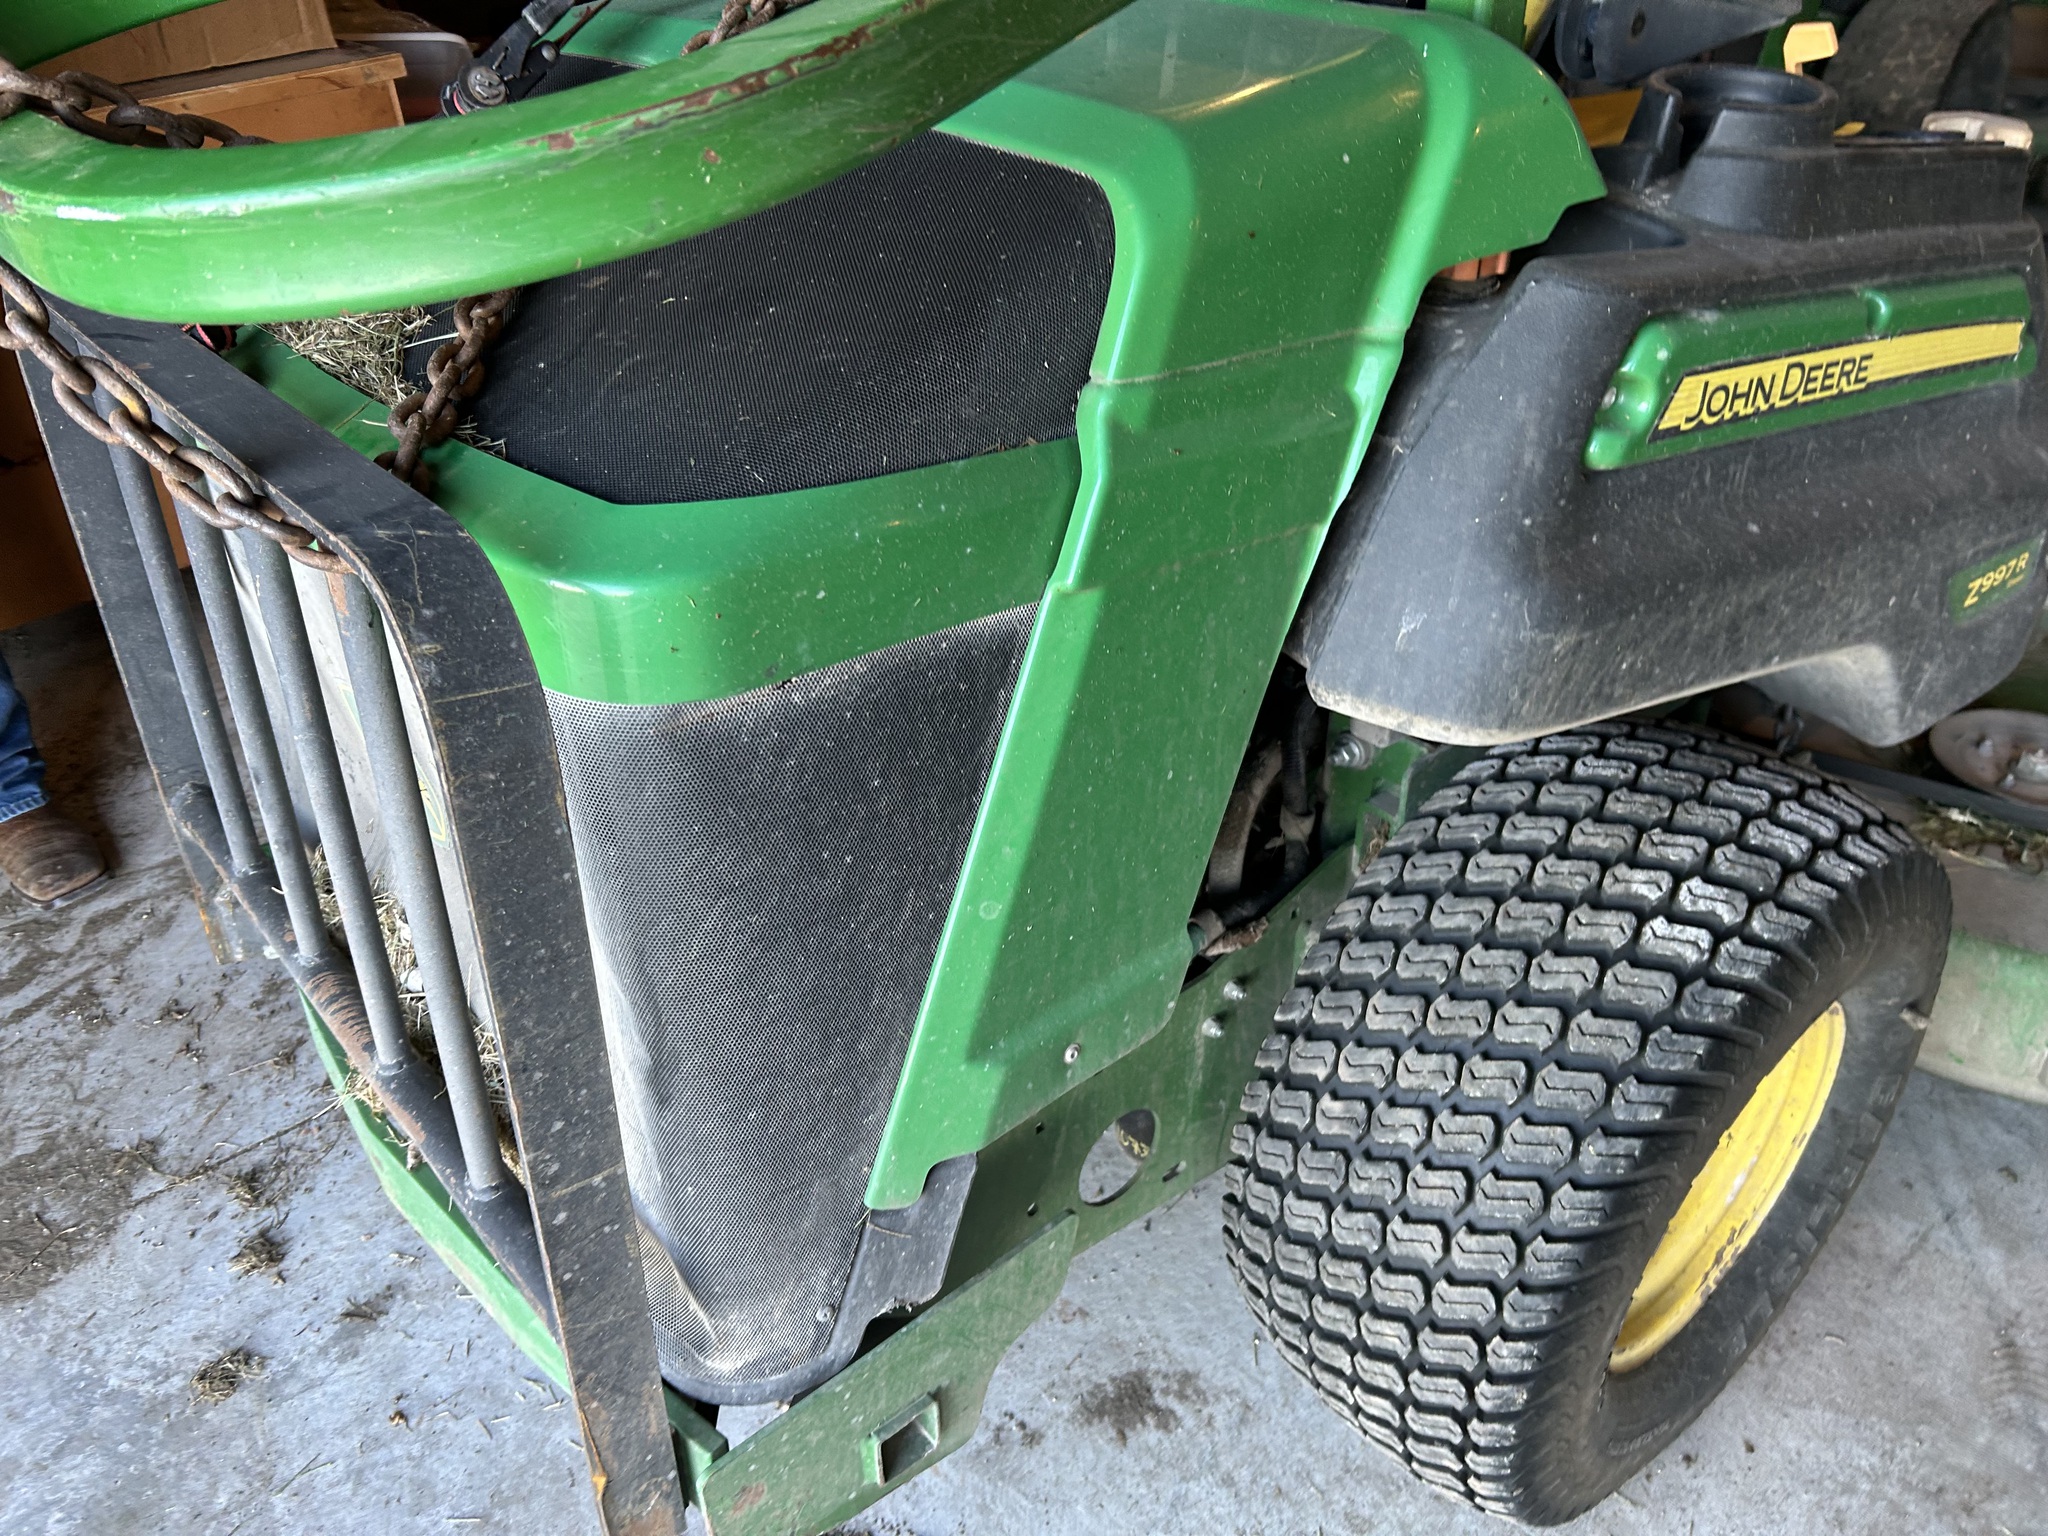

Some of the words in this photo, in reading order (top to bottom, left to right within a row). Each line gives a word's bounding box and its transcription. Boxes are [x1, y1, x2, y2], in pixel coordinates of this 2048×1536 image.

[1684, 375, 1776, 423] JOHN
[1779, 354, 1874, 402] DEERE
[1963, 551, 2030, 608] Z997R
